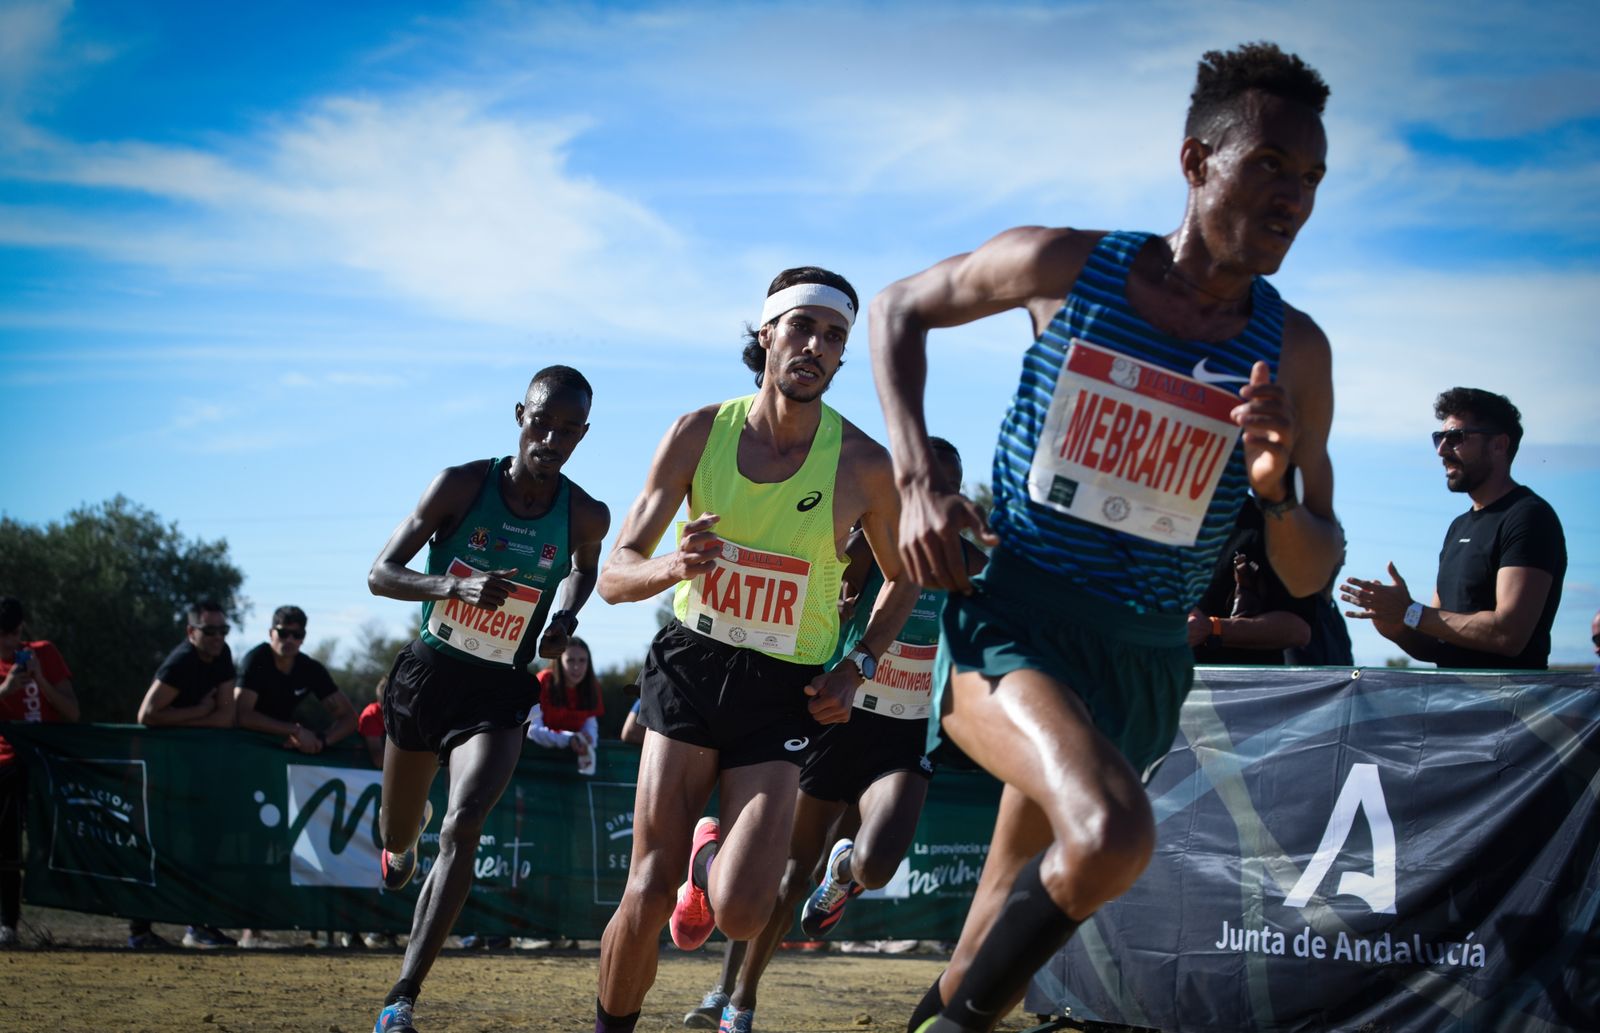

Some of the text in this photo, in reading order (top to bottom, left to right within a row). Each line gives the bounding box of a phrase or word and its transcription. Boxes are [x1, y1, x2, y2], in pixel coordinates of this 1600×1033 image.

[1059, 389, 1228, 500] MEBRAHTU
[502, 522, 527, 535] luanvi
[701, 566, 798, 626] KATIR
[445, 599, 525, 641] Kwizera
[872, 659, 933, 696] dikumwena
[914, 842, 929, 855] La
[930, 843, 981, 856] provincia
[1215, 920, 1486, 968] Junta de Andalucía
